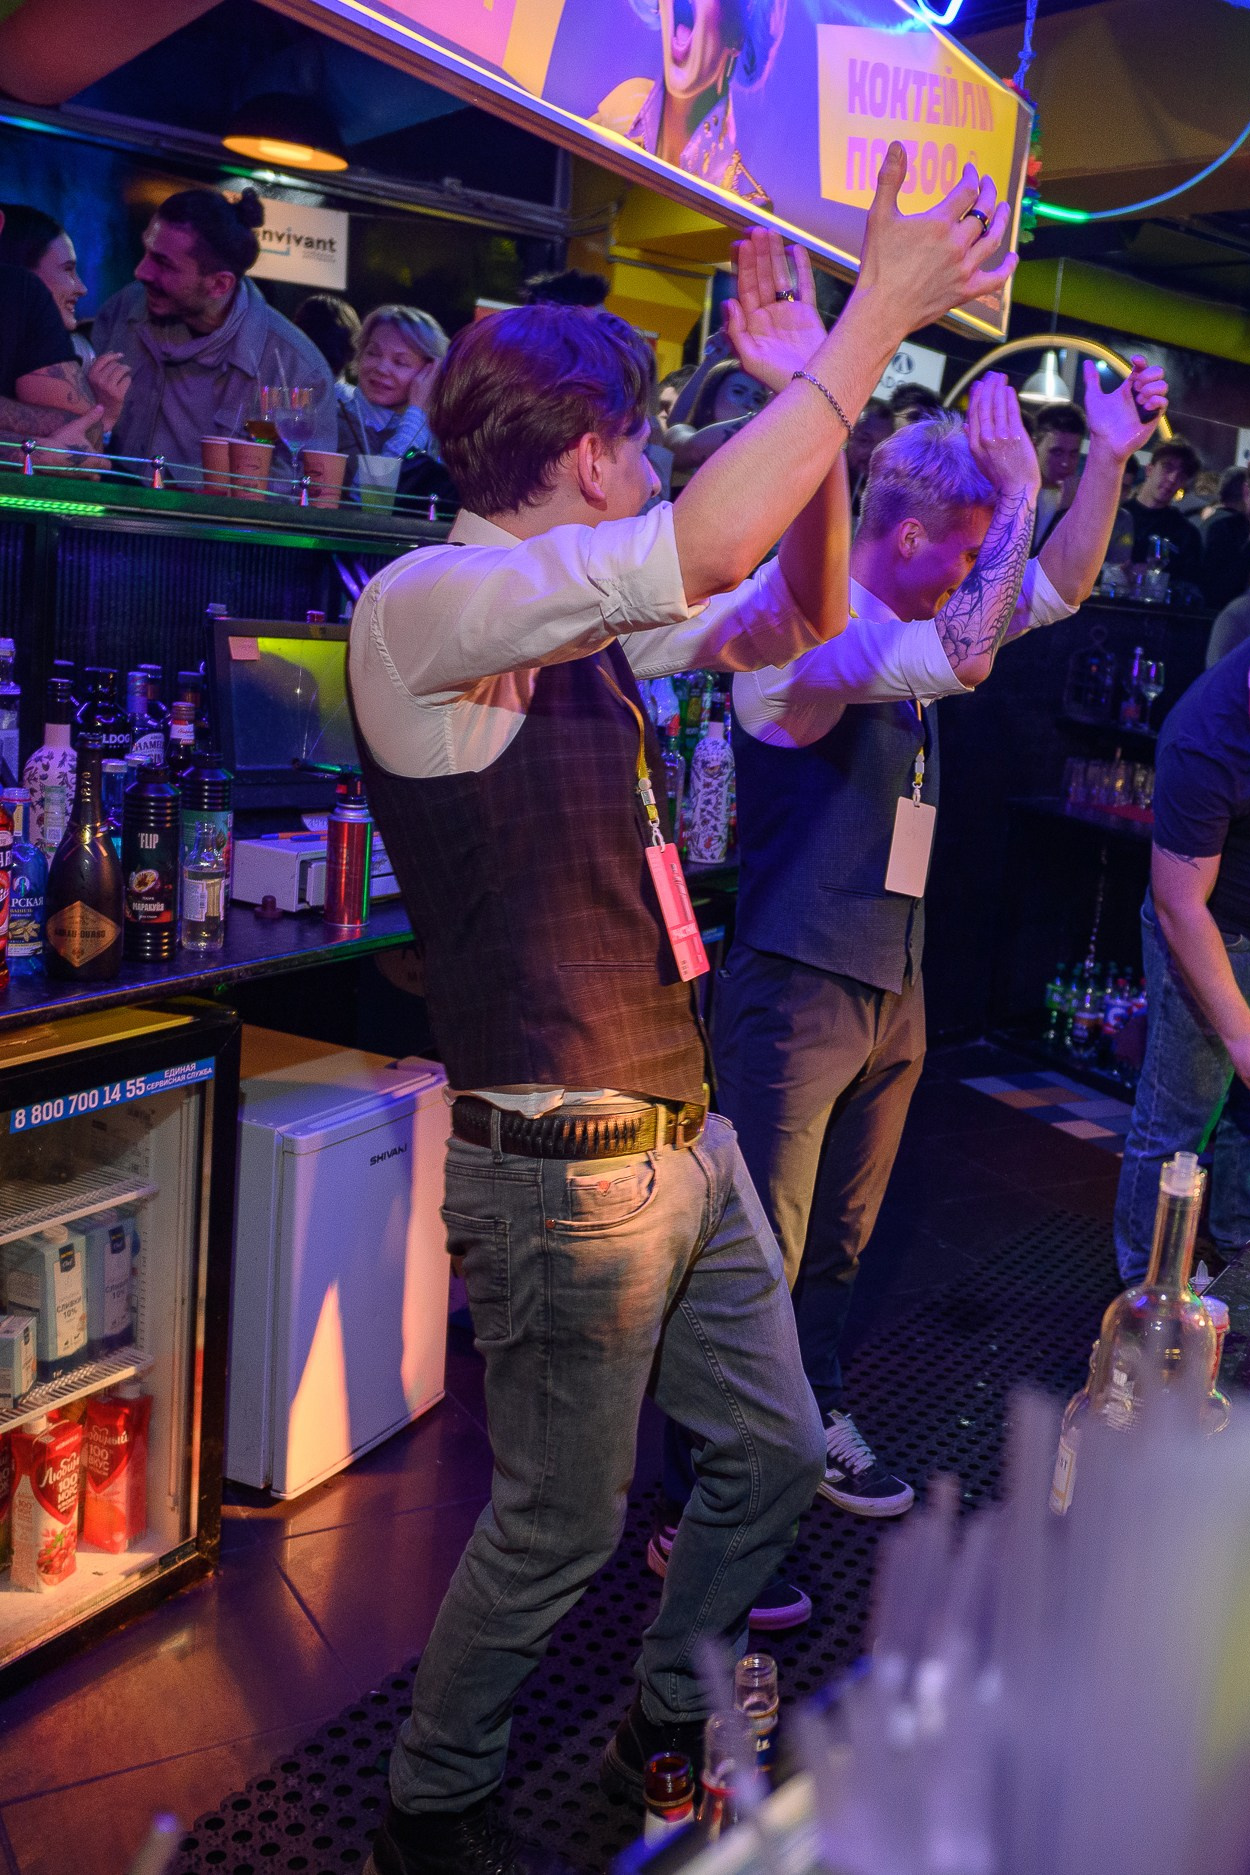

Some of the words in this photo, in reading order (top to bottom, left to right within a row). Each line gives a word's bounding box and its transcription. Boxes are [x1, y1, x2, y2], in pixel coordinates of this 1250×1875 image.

[848, 58, 994, 132] КОКТЕЙЛИ
[257, 226, 336, 254] nvivant
[101, 732, 131, 745] LDOG
[146, 1074, 186, 1090] СЕРВИСНАЯ
[186, 1067, 213, 1080] СЛУЖБА
[164, 1062, 197, 1078] ЕДИНАЯ
[14, 1109, 26, 1129] 8
[31, 1099, 65, 1125] 800
[68, 1089, 99, 1115] 700
[103, 1082, 121, 1105] 14
[126, 1077, 146, 1099] 55
[56, 1296, 82, 1313] СЛИВКИ
[63, 1307, 78, 1318] 10%
[58, 1472, 78, 1494] 100
